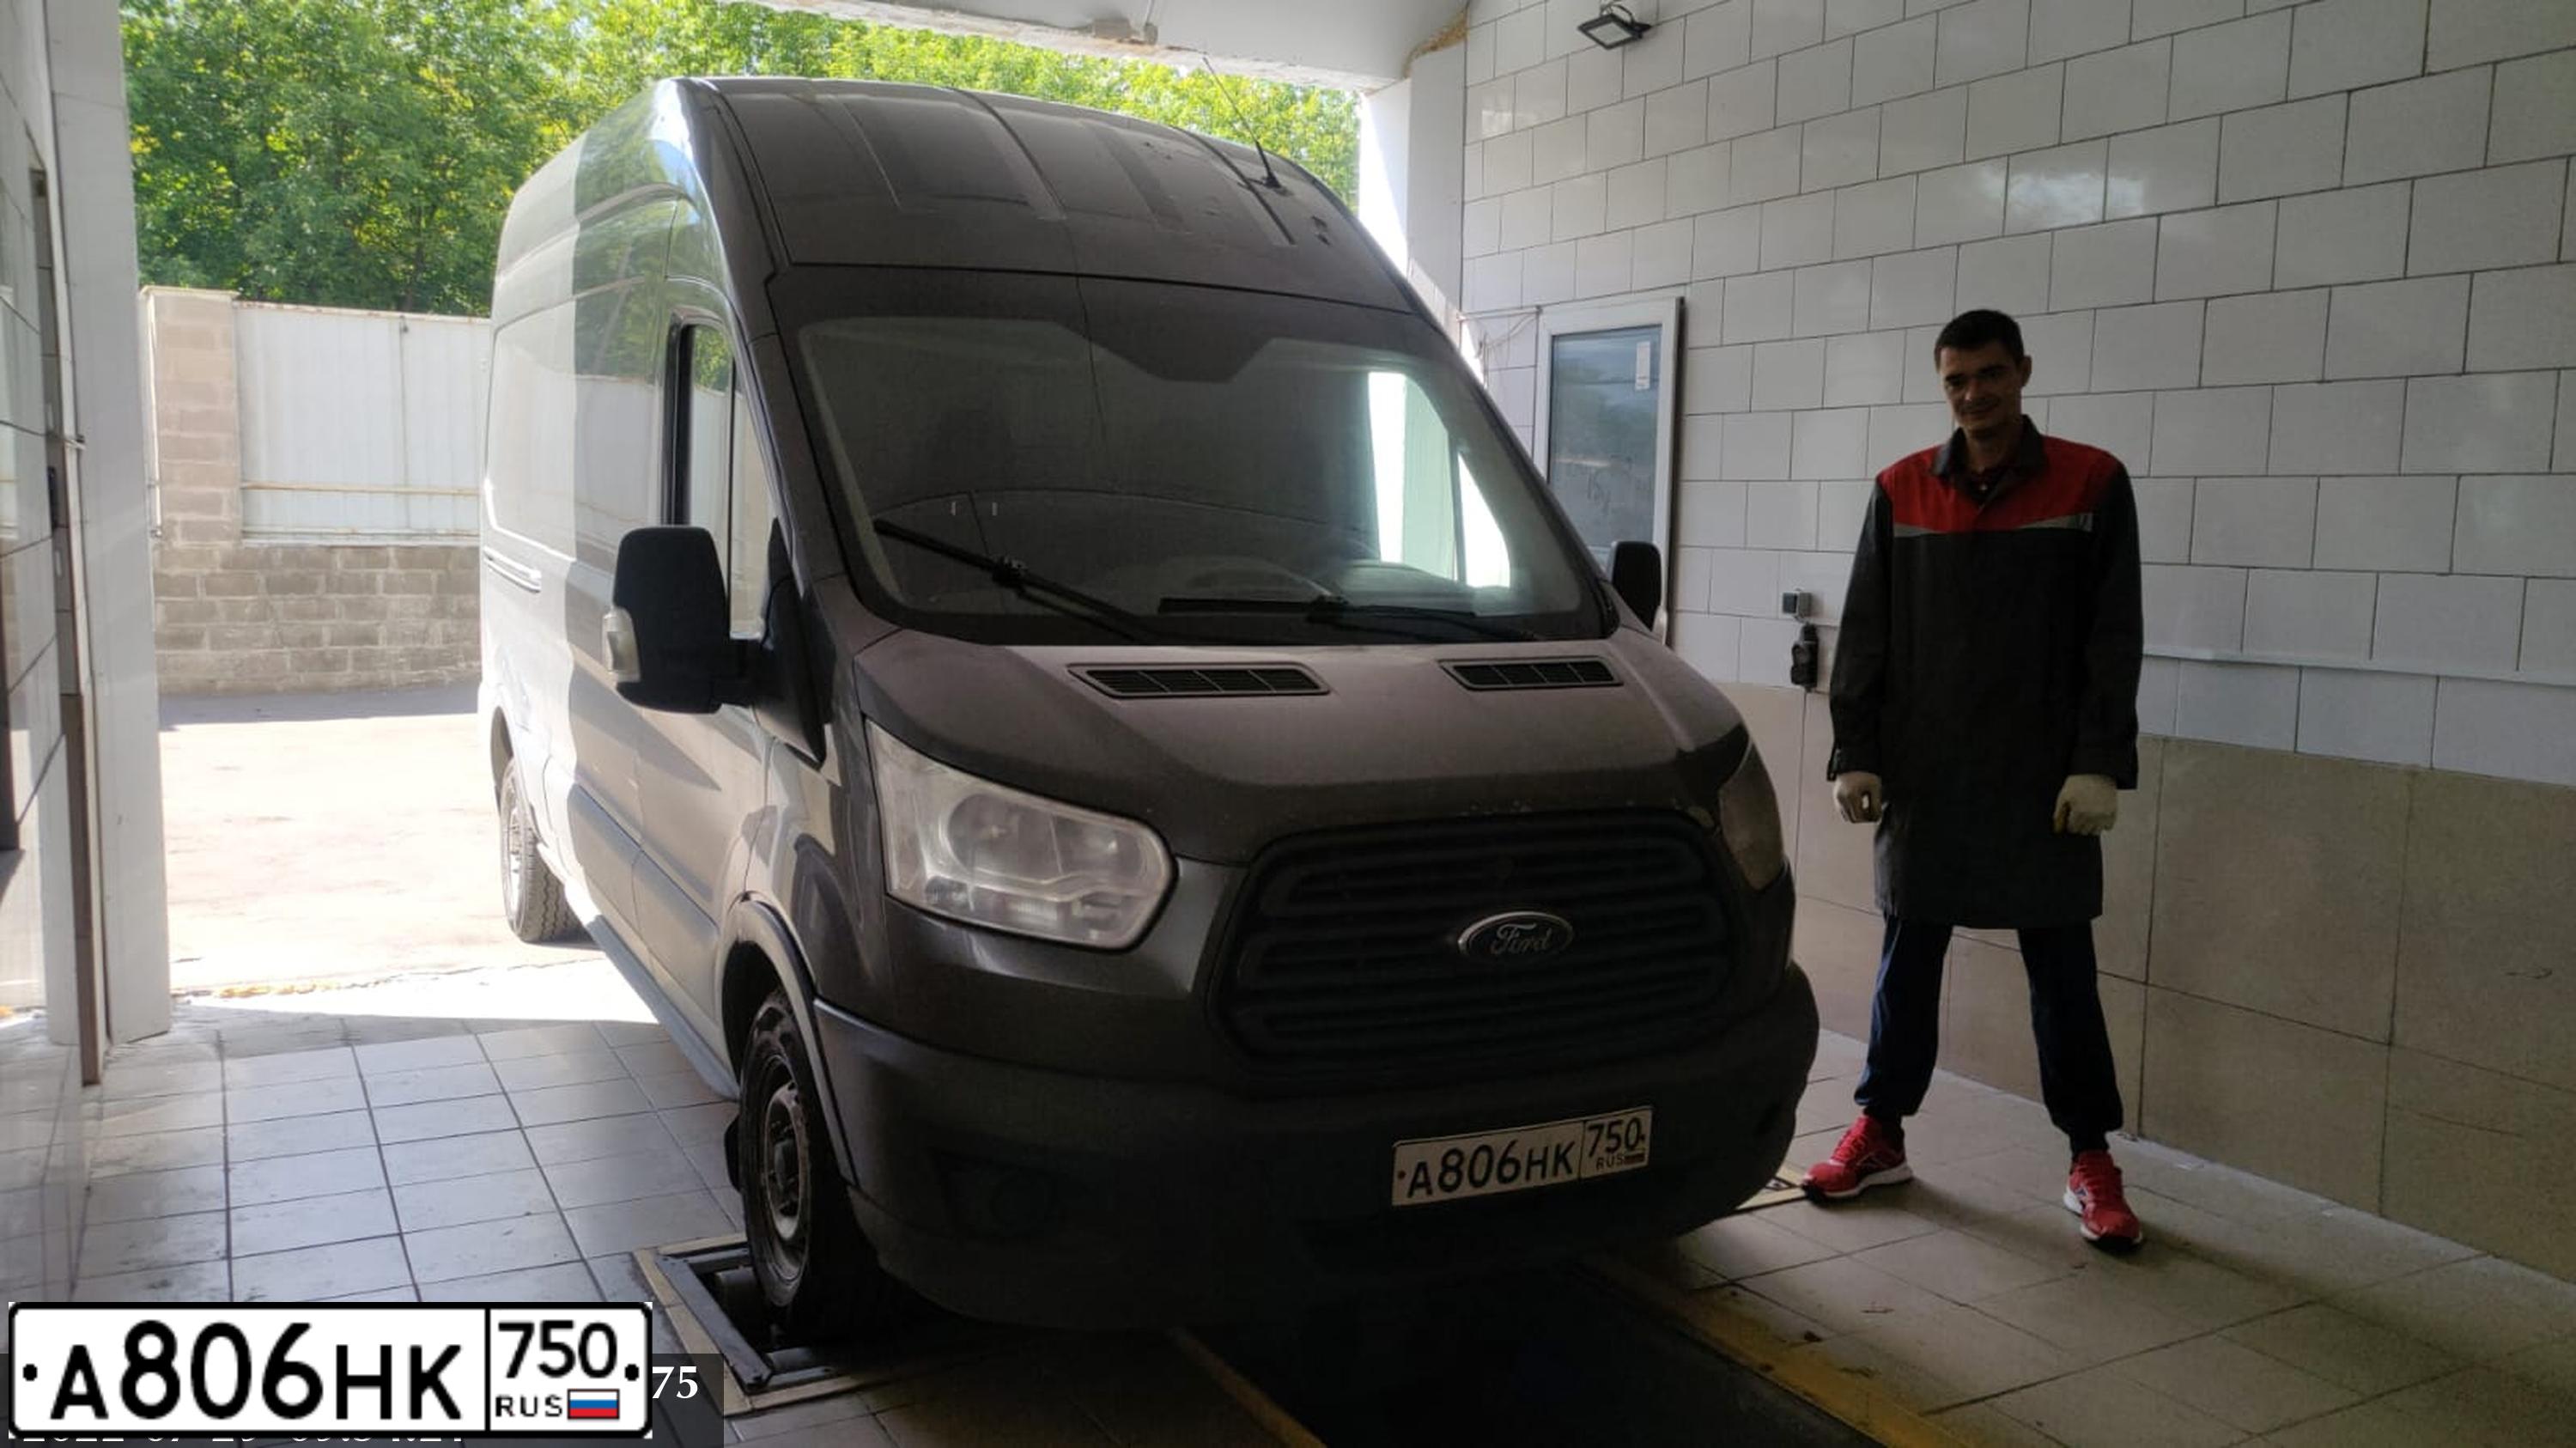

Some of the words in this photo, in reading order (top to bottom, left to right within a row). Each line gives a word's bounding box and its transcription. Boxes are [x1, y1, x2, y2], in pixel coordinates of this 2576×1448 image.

[1491, 923, 1552, 955] Ford
[1589, 1118, 1641, 1157] 750
[1595, 1156, 1624, 1170] RUS
